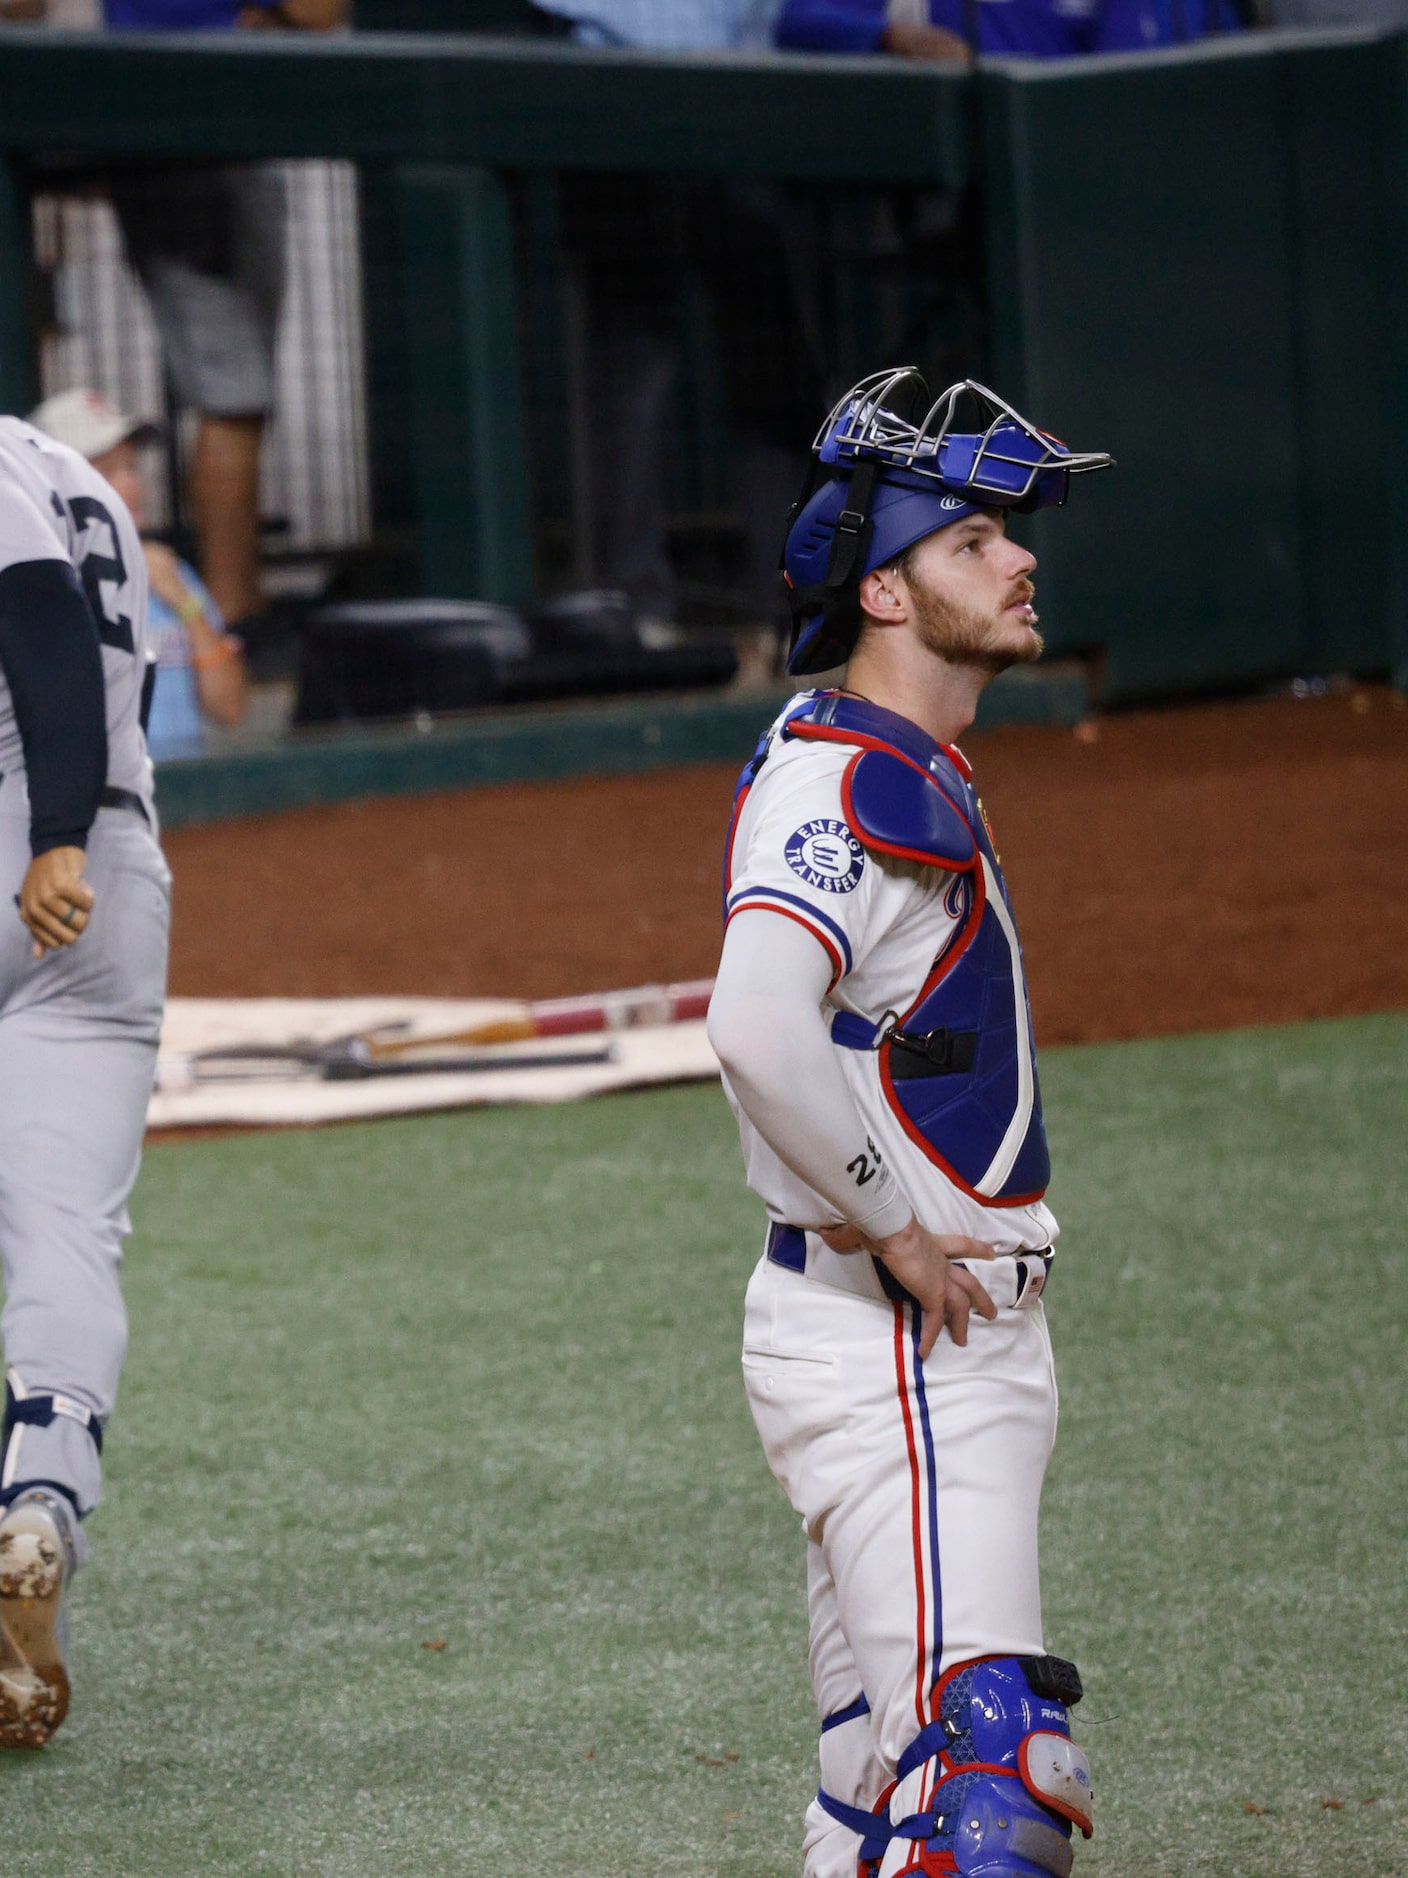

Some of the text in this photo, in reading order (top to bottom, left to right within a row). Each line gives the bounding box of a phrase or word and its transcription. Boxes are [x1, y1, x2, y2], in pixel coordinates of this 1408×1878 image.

[50, 490, 135, 655] 2
[796, 820, 865, 866] ENERGY
[786, 847, 858, 893] TRANSFER
